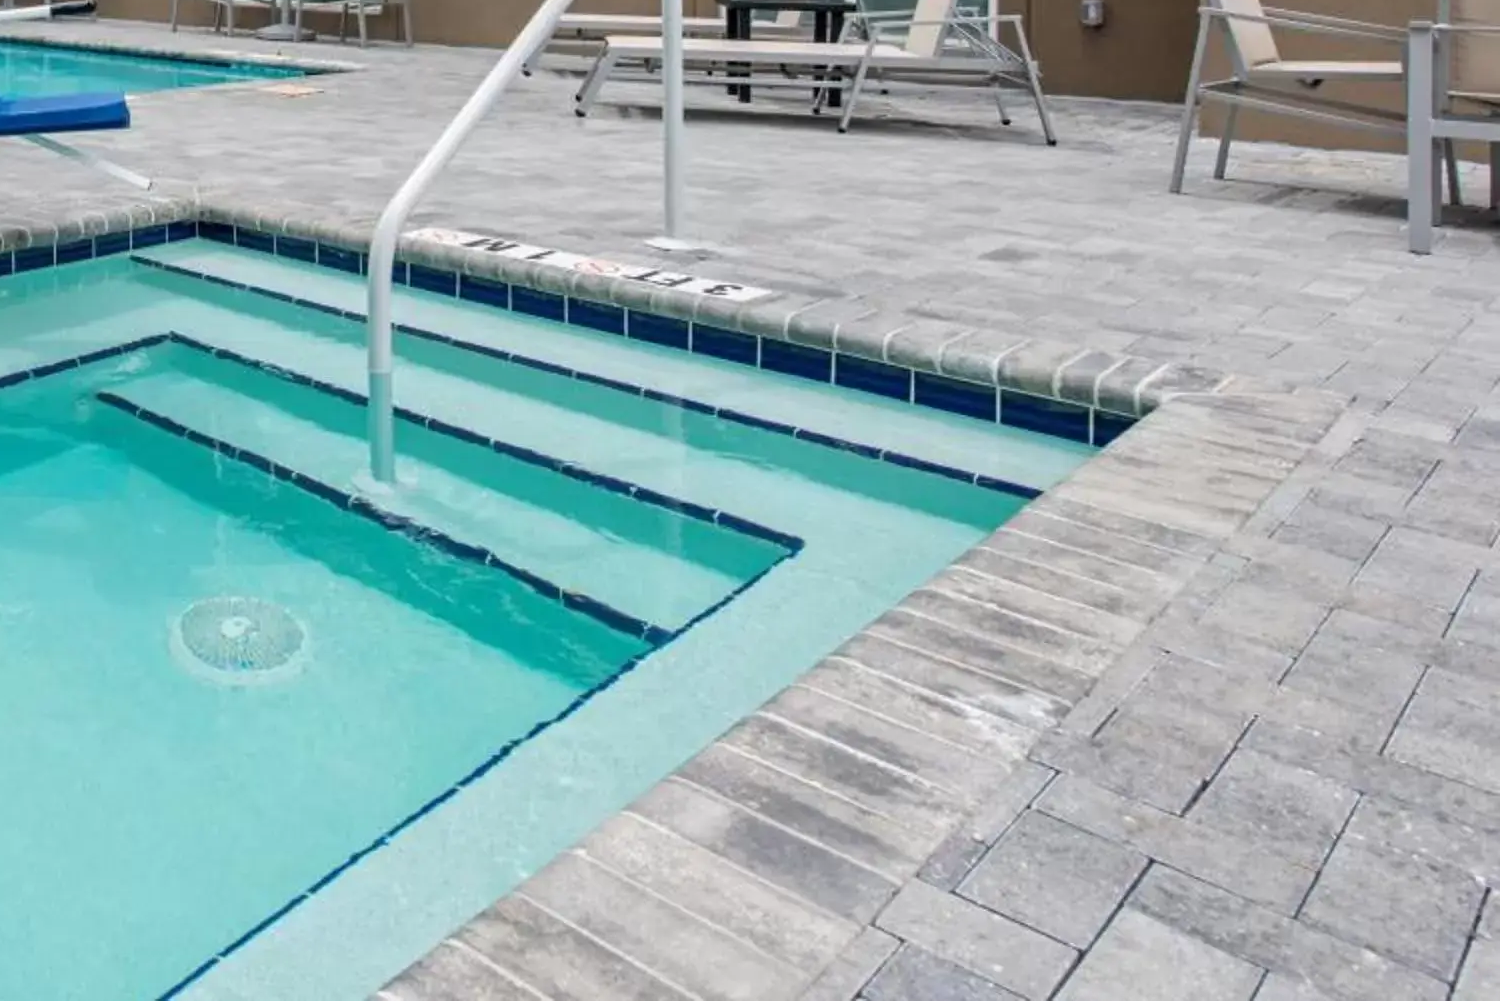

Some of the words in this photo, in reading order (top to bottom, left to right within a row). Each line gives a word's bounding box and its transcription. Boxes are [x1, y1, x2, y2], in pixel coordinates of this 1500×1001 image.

[462, 237, 520, 252] M
[625, 269, 694, 288] FT
[703, 283, 744, 296] 3
